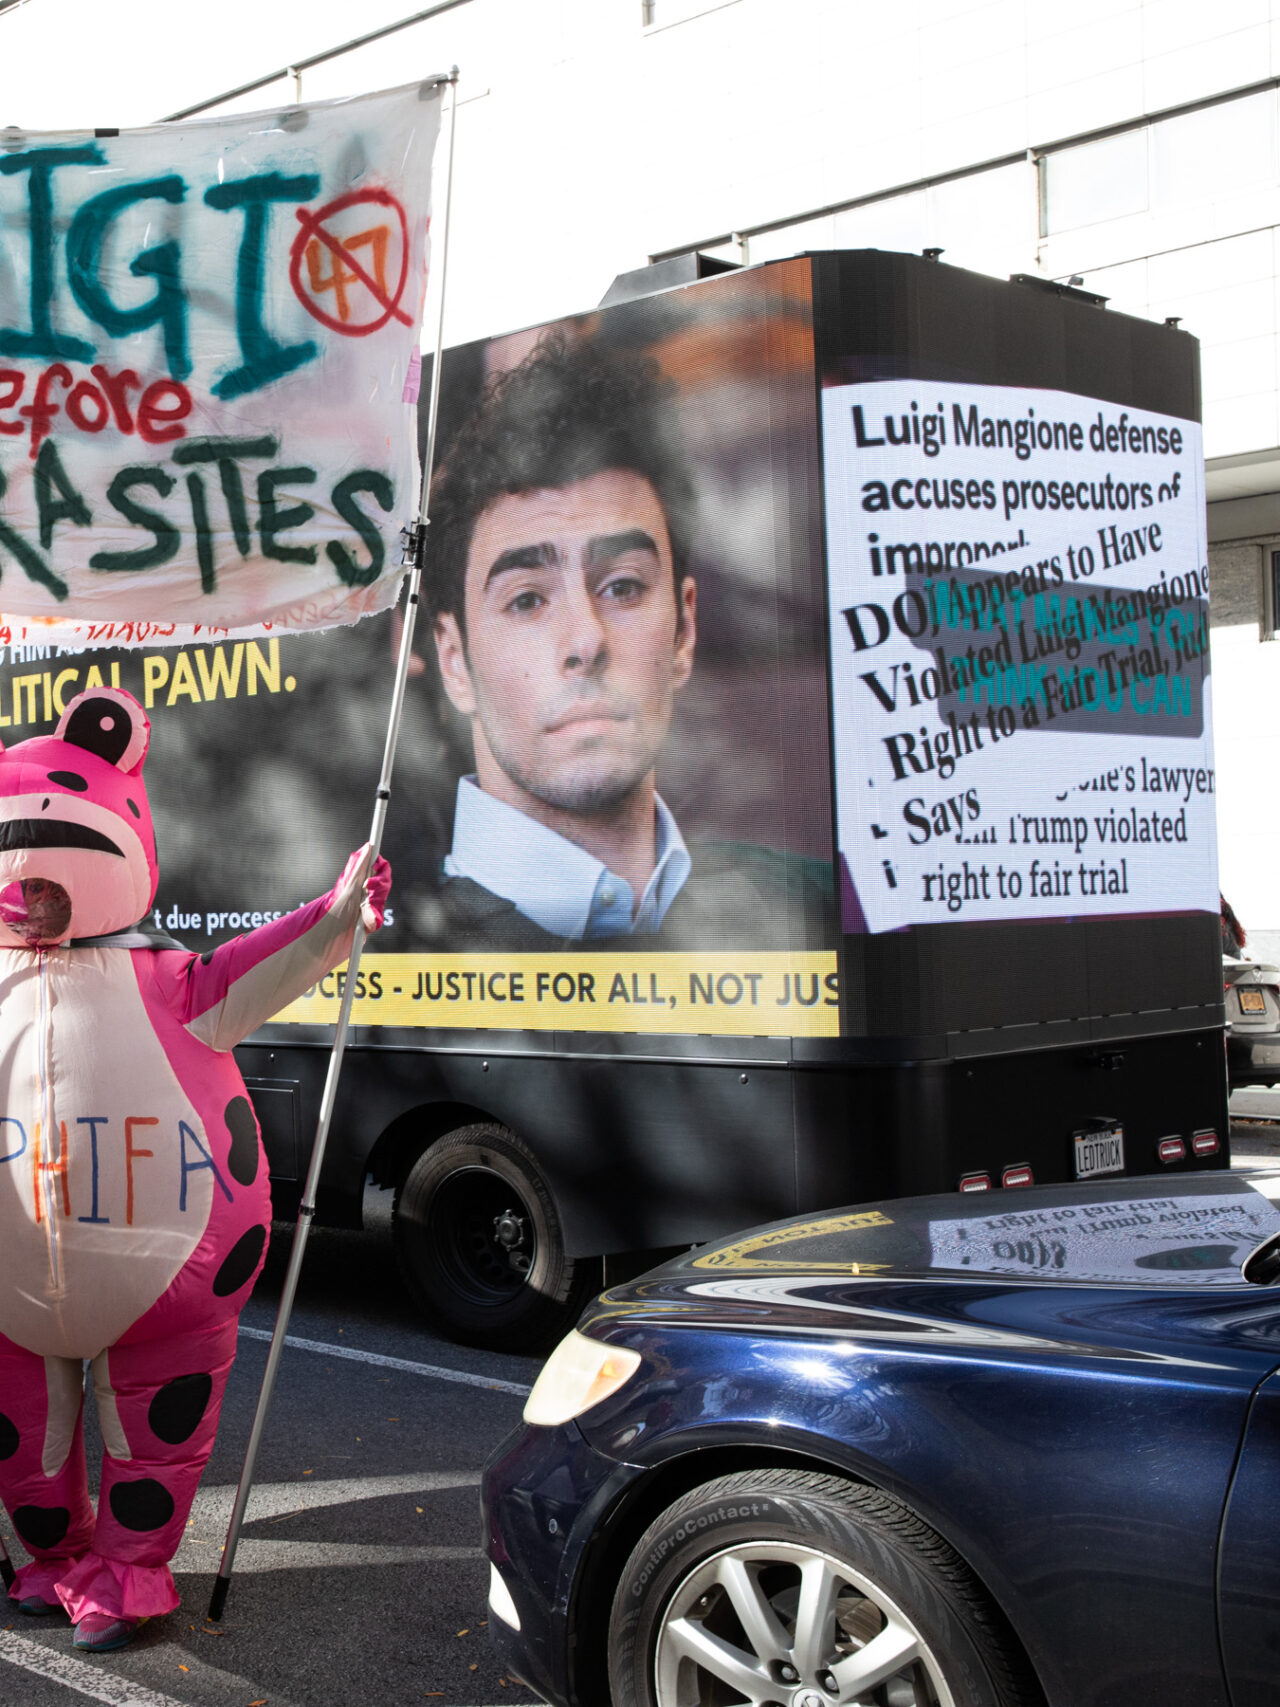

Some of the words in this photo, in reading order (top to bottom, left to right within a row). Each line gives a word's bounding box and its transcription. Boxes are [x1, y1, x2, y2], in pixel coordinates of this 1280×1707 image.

[850, 401, 948, 459] Luigi
[953, 403, 1084, 460] Mangione
[1089, 412, 1183, 455] defense
[861, 476, 997, 513] accuses
[1002, 472, 1153, 521] prosecutors
[1068, 544, 1095, 580] to
[1097, 523, 1163, 569] Have
[144, 638, 298, 709] PAWN.
[860, 624, 1012, 715] Violated
[1131, 672, 1191, 717] CAN
[882, 709, 985, 781] Right
[987, 699, 1017, 742] to
[1022, 704, 1040, 730] a
[1042, 665, 1095, 720] Fair
[903, 788, 980, 845] Says
[1094, 807, 1188, 844] violated
[922, 861, 990, 912] right
[997, 864, 1021, 899] to
[1030, 860, 1071, 898] fair
[1079, 858, 1129, 896] trial
[166, 904, 202, 931] due
[207, 908, 282, 936] process
[303, 970, 383, 1001] CESS
[411, 970, 523, 1002] JUSTICE
[536, 971, 597, 1003] FOR
[607, 972, 678, 1010] ALL,
[688, 972, 762, 1007] NOT
[1077, 1139, 1121, 1173] LEDTRUCK
[630, 1503, 760, 1597] ContiProContact
